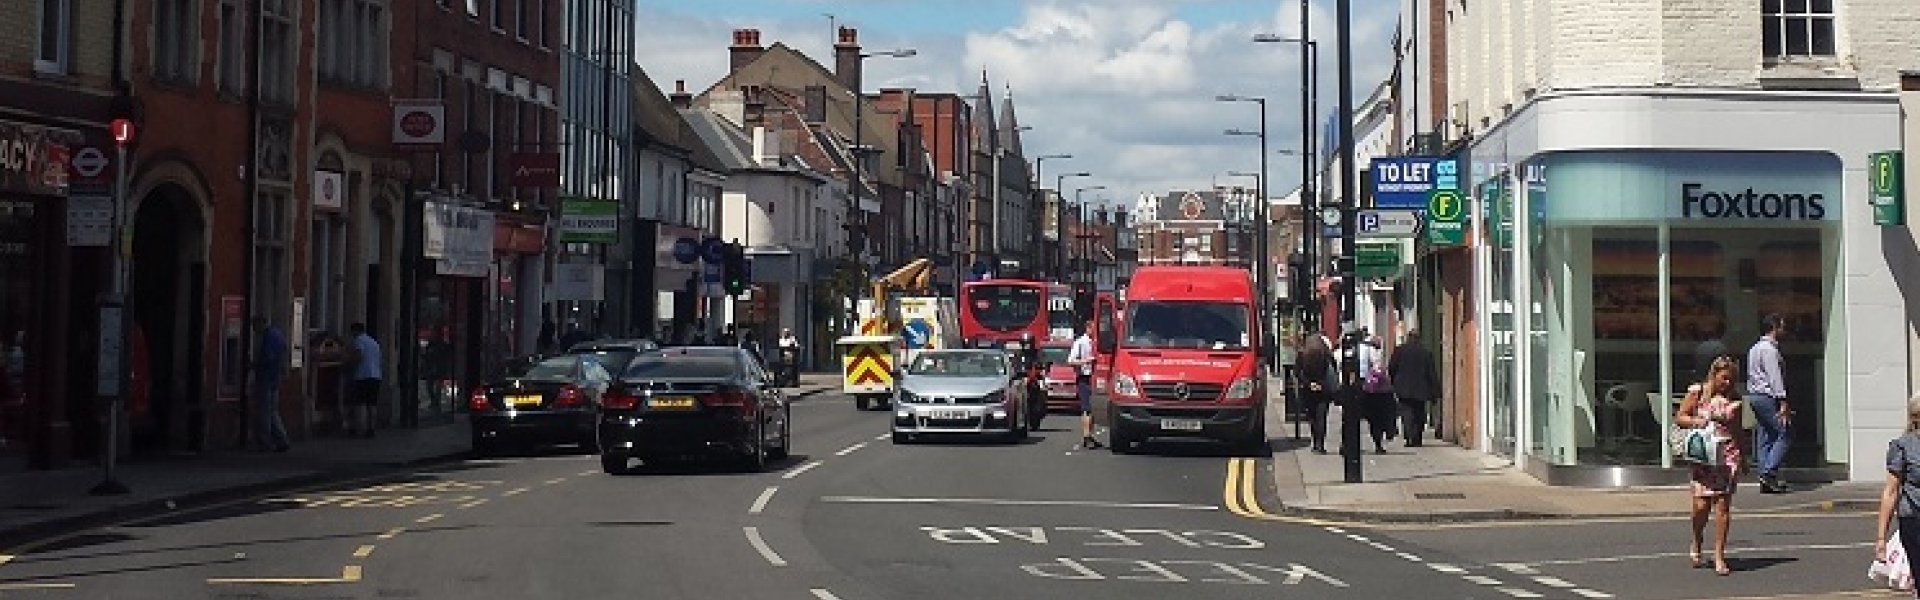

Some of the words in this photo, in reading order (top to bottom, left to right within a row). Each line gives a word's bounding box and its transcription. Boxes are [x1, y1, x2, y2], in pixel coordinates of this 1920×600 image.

[1378, 162, 1400, 182] TO
[1403, 162, 1431, 182] LET
[1439, 196, 1452, 216] F
[1682, 183, 1825, 220] Foxtons
[919, 526, 1266, 548] CLEAR
[1019, 557, 1350, 587] KEEP
